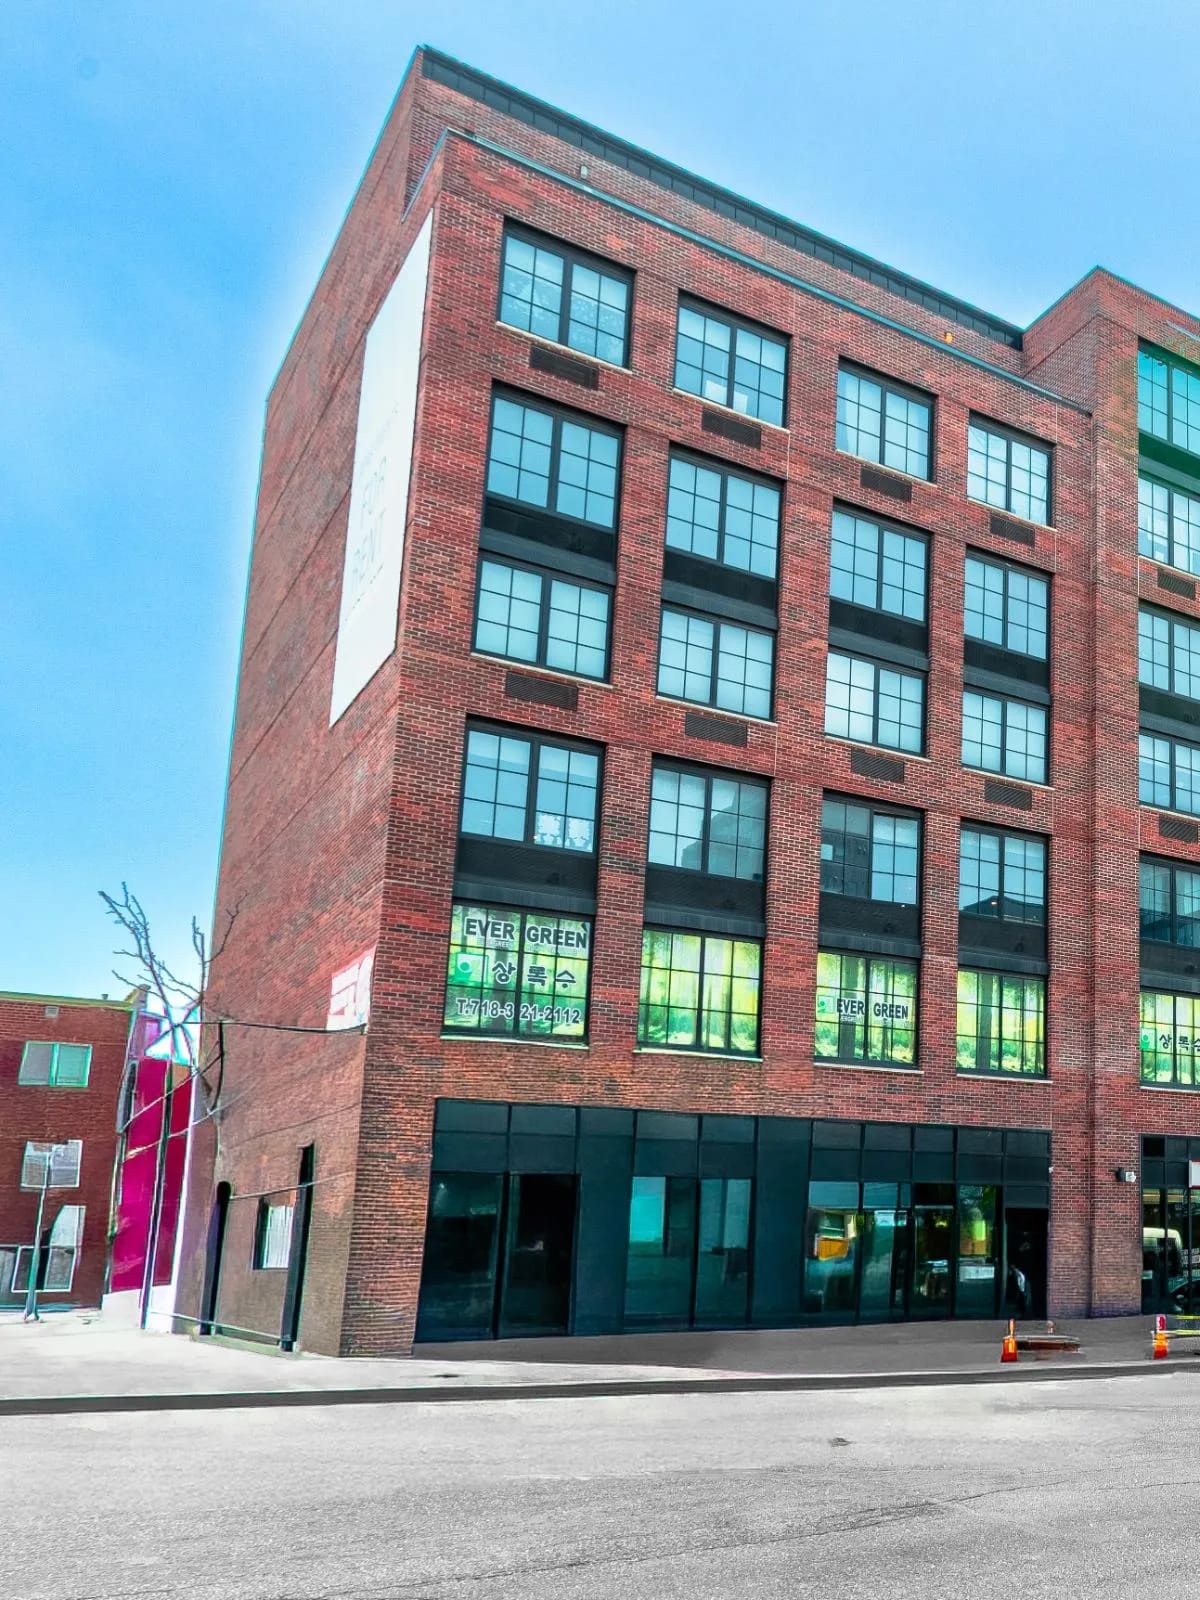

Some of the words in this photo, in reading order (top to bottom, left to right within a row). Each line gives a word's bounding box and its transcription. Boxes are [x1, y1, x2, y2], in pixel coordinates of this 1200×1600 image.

[464, 918, 515, 941] EVER
[526, 925, 587, 949] GREEN
[492, 961, 577, 989] 상록수
[837, 998, 865, 1016] EVER
[873, 1002, 909, 1020] GREEN
